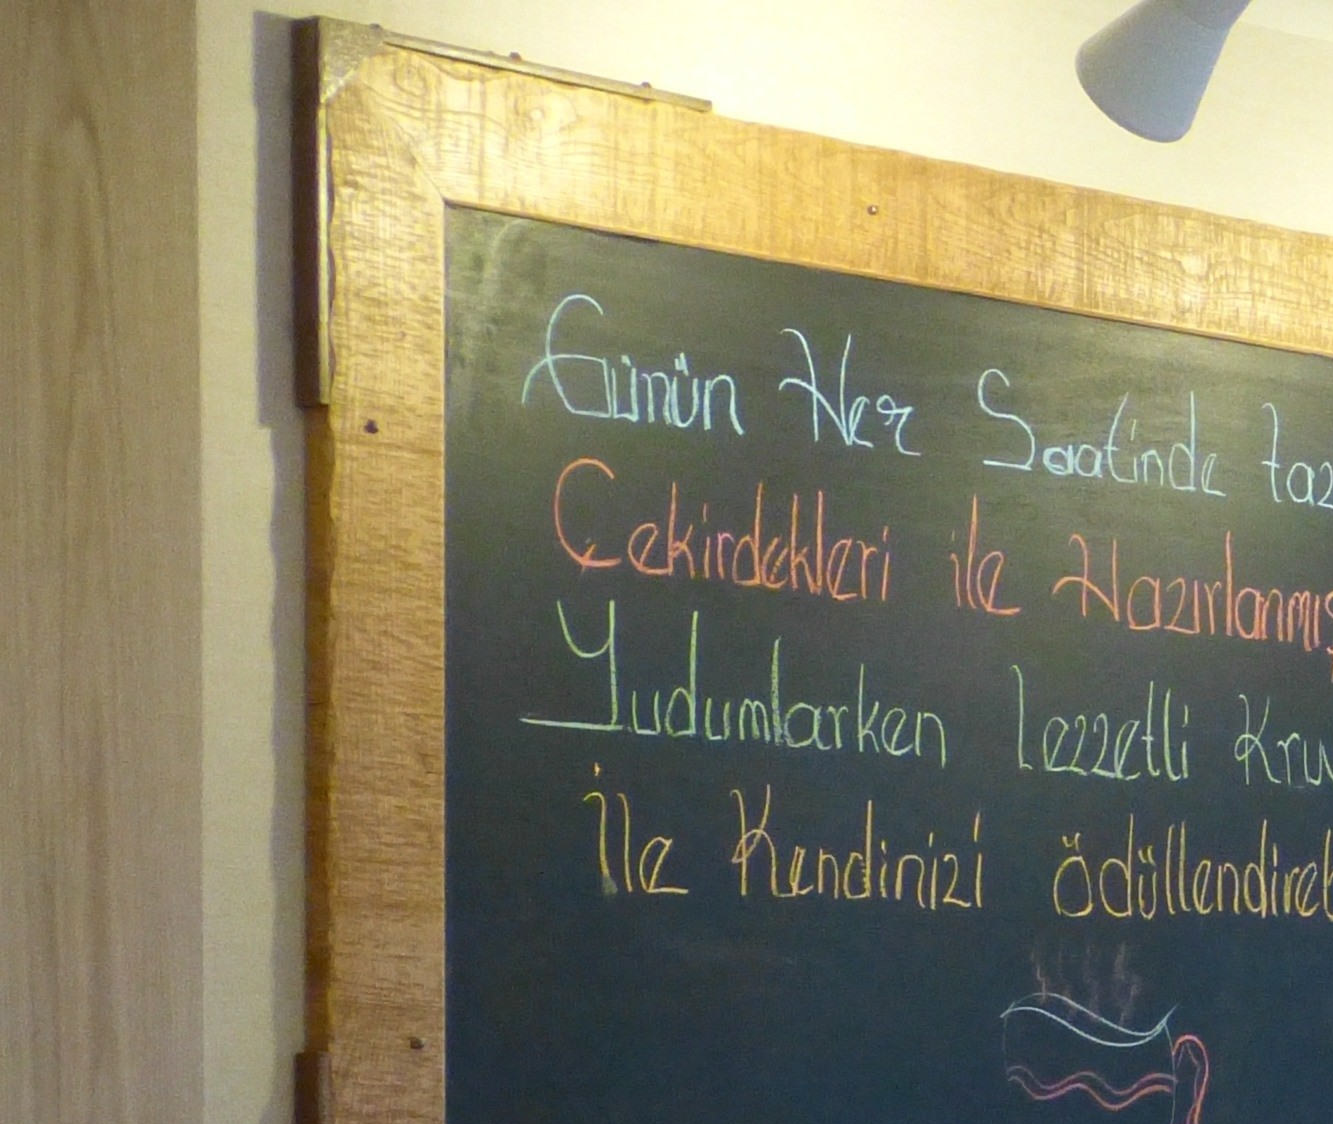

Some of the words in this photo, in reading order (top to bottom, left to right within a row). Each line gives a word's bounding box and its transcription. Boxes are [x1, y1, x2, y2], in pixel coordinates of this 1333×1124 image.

[522, 294, 744, 436] Günün
[779, 328, 920, 457] Her
[977, 368, 1227, 498] Saatinde
[950, 494, 1021, 616] ile
[519, 600, 946, 770] Yudumlarken
[730, 784, 984, 912] Kendinizi
